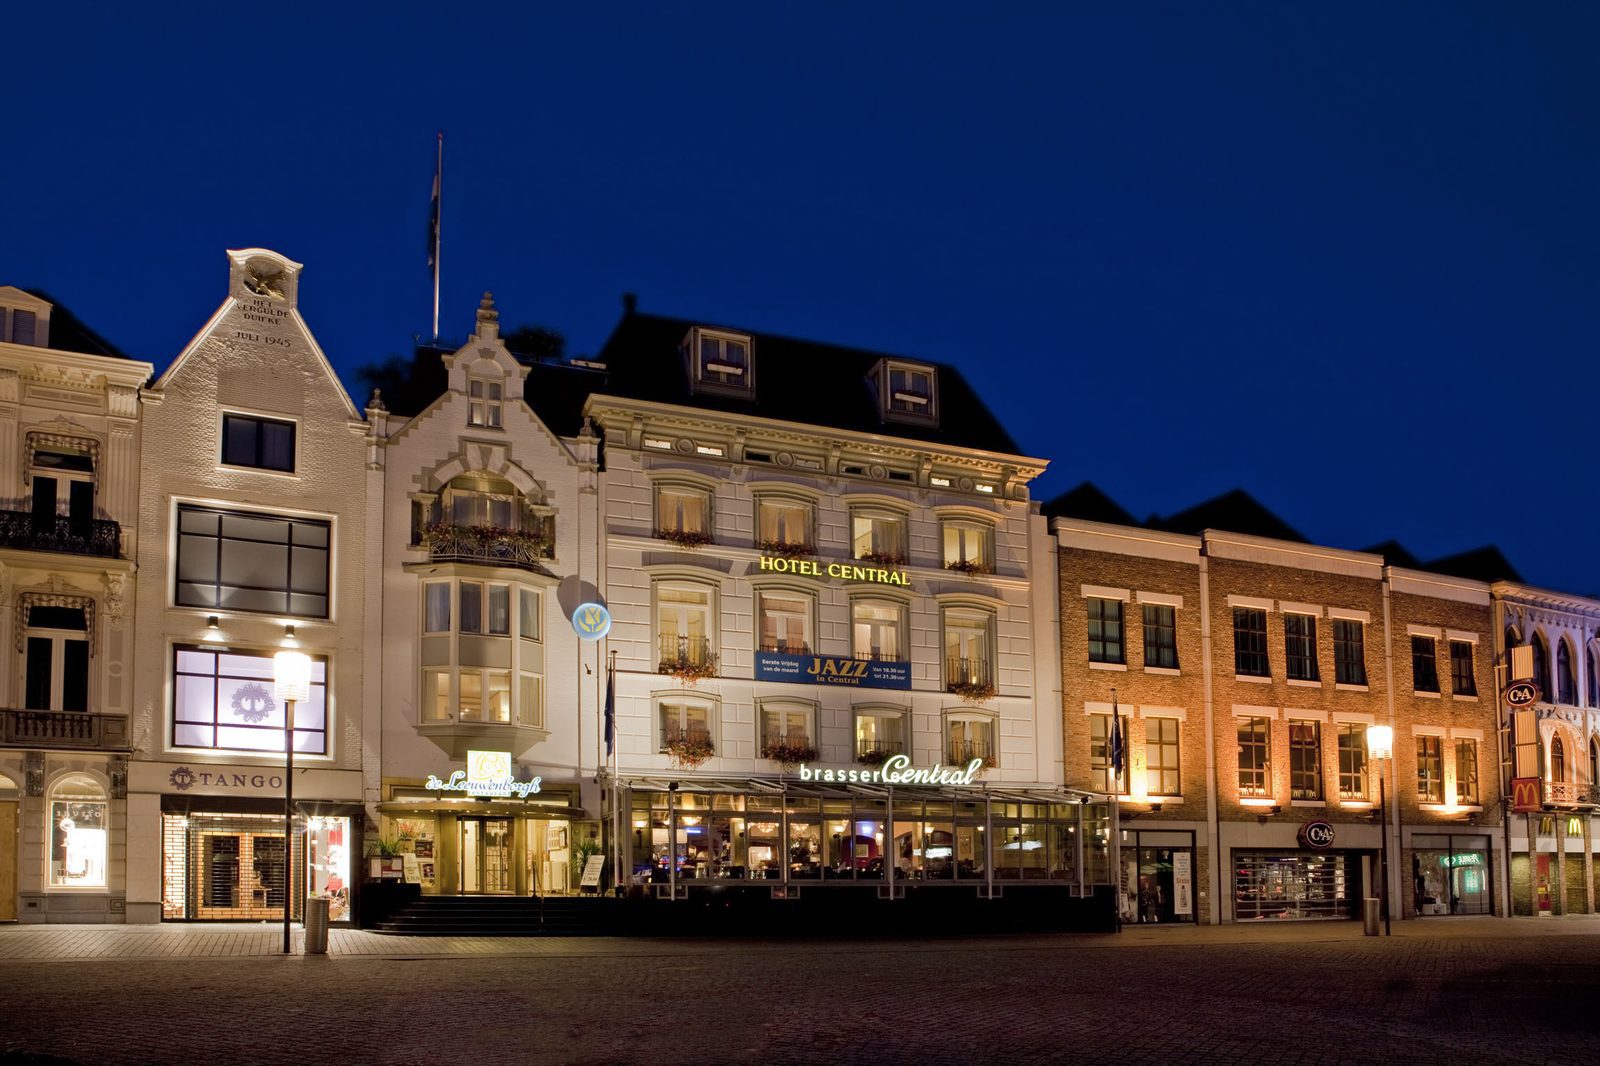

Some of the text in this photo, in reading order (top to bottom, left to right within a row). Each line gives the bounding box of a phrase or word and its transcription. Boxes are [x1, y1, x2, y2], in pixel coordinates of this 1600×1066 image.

[237, 303, 289, 318] VERGULDE
[253, 299, 272, 308] HET
[235, 331, 291, 348] JULI 1945
[760, 556, 911, 586] HOTEL CENTRAL
[807, 657, 869, 678] JAZZ
[828, 676, 859, 684] Central
[1510, 688, 1532, 701] C&A
[881, 754, 982, 785] Central
[199, 772, 283, 789] TANGO
[426, 771, 541, 797] de Leeuwenborgh
[1310, 827, 1331, 841] C&A
